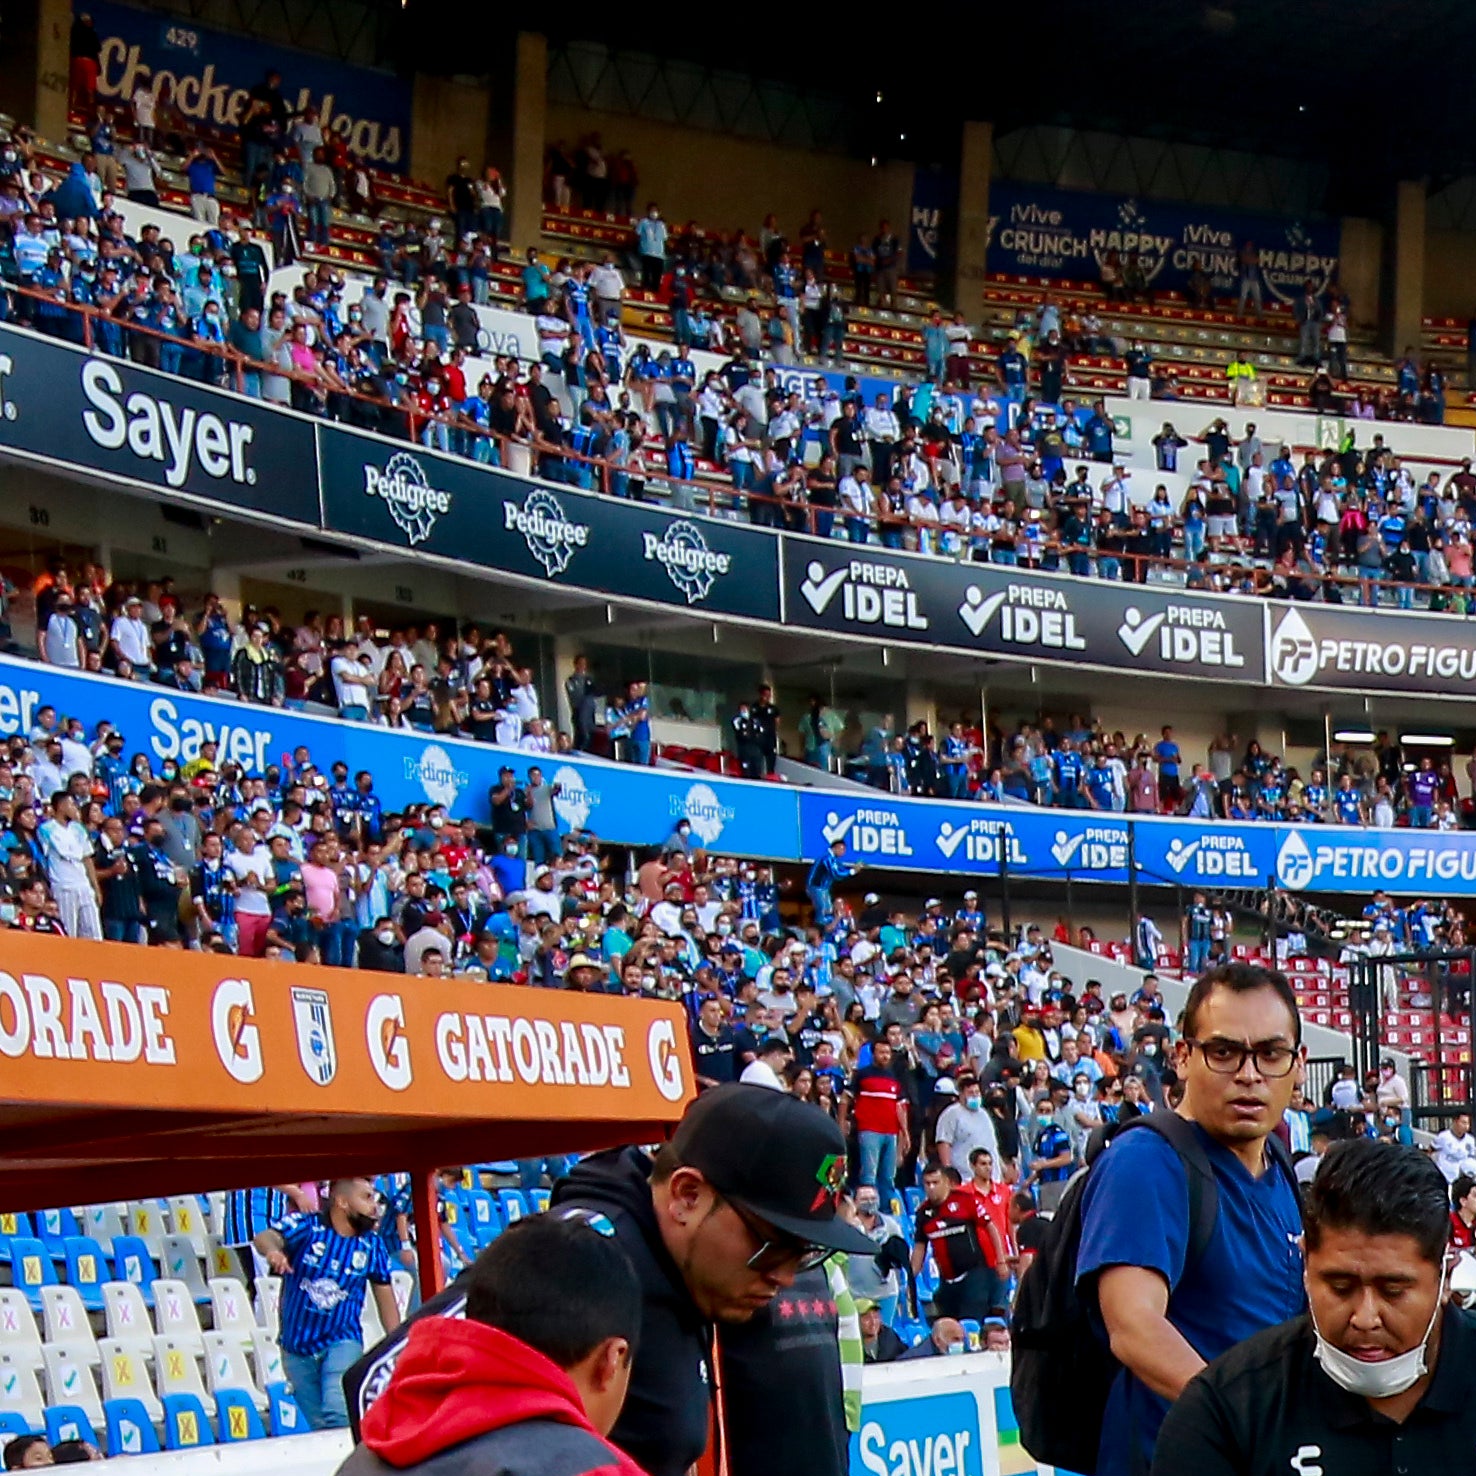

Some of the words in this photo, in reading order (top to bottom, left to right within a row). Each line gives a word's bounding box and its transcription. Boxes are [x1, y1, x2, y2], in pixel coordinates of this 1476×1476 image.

[1000, 229, 1088, 261] CRUNCH
[1089, 228, 1174, 257] HAPPY
[1259, 248, 1338, 277] HAPPY
[81, 357, 254, 488] Sayer
[363, 465, 448, 514] Pedigree
[503, 501, 588, 547] Pedigree
[642, 531, 730, 575] Pedigree
[850, 561, 909, 588] PREPA
[843, 583, 929, 631] IDEL
[1008, 585, 1068, 611] PREPA
[1001, 606, 1087, 651] IDEL
[1167, 605, 1226, 630] PREPA
[1160, 626, 1246, 668] IDEL
[404, 756, 468, 786] Pedigree
[669, 795, 734, 821] Pedigree
[857, 809, 899, 828] PREPA
[853, 826, 914, 857] IDEL
[1201, 835, 1245, 850] PREPA
[1196, 850, 1258, 877] IDEL
[436, 1012, 631, 1089] GATORADE
